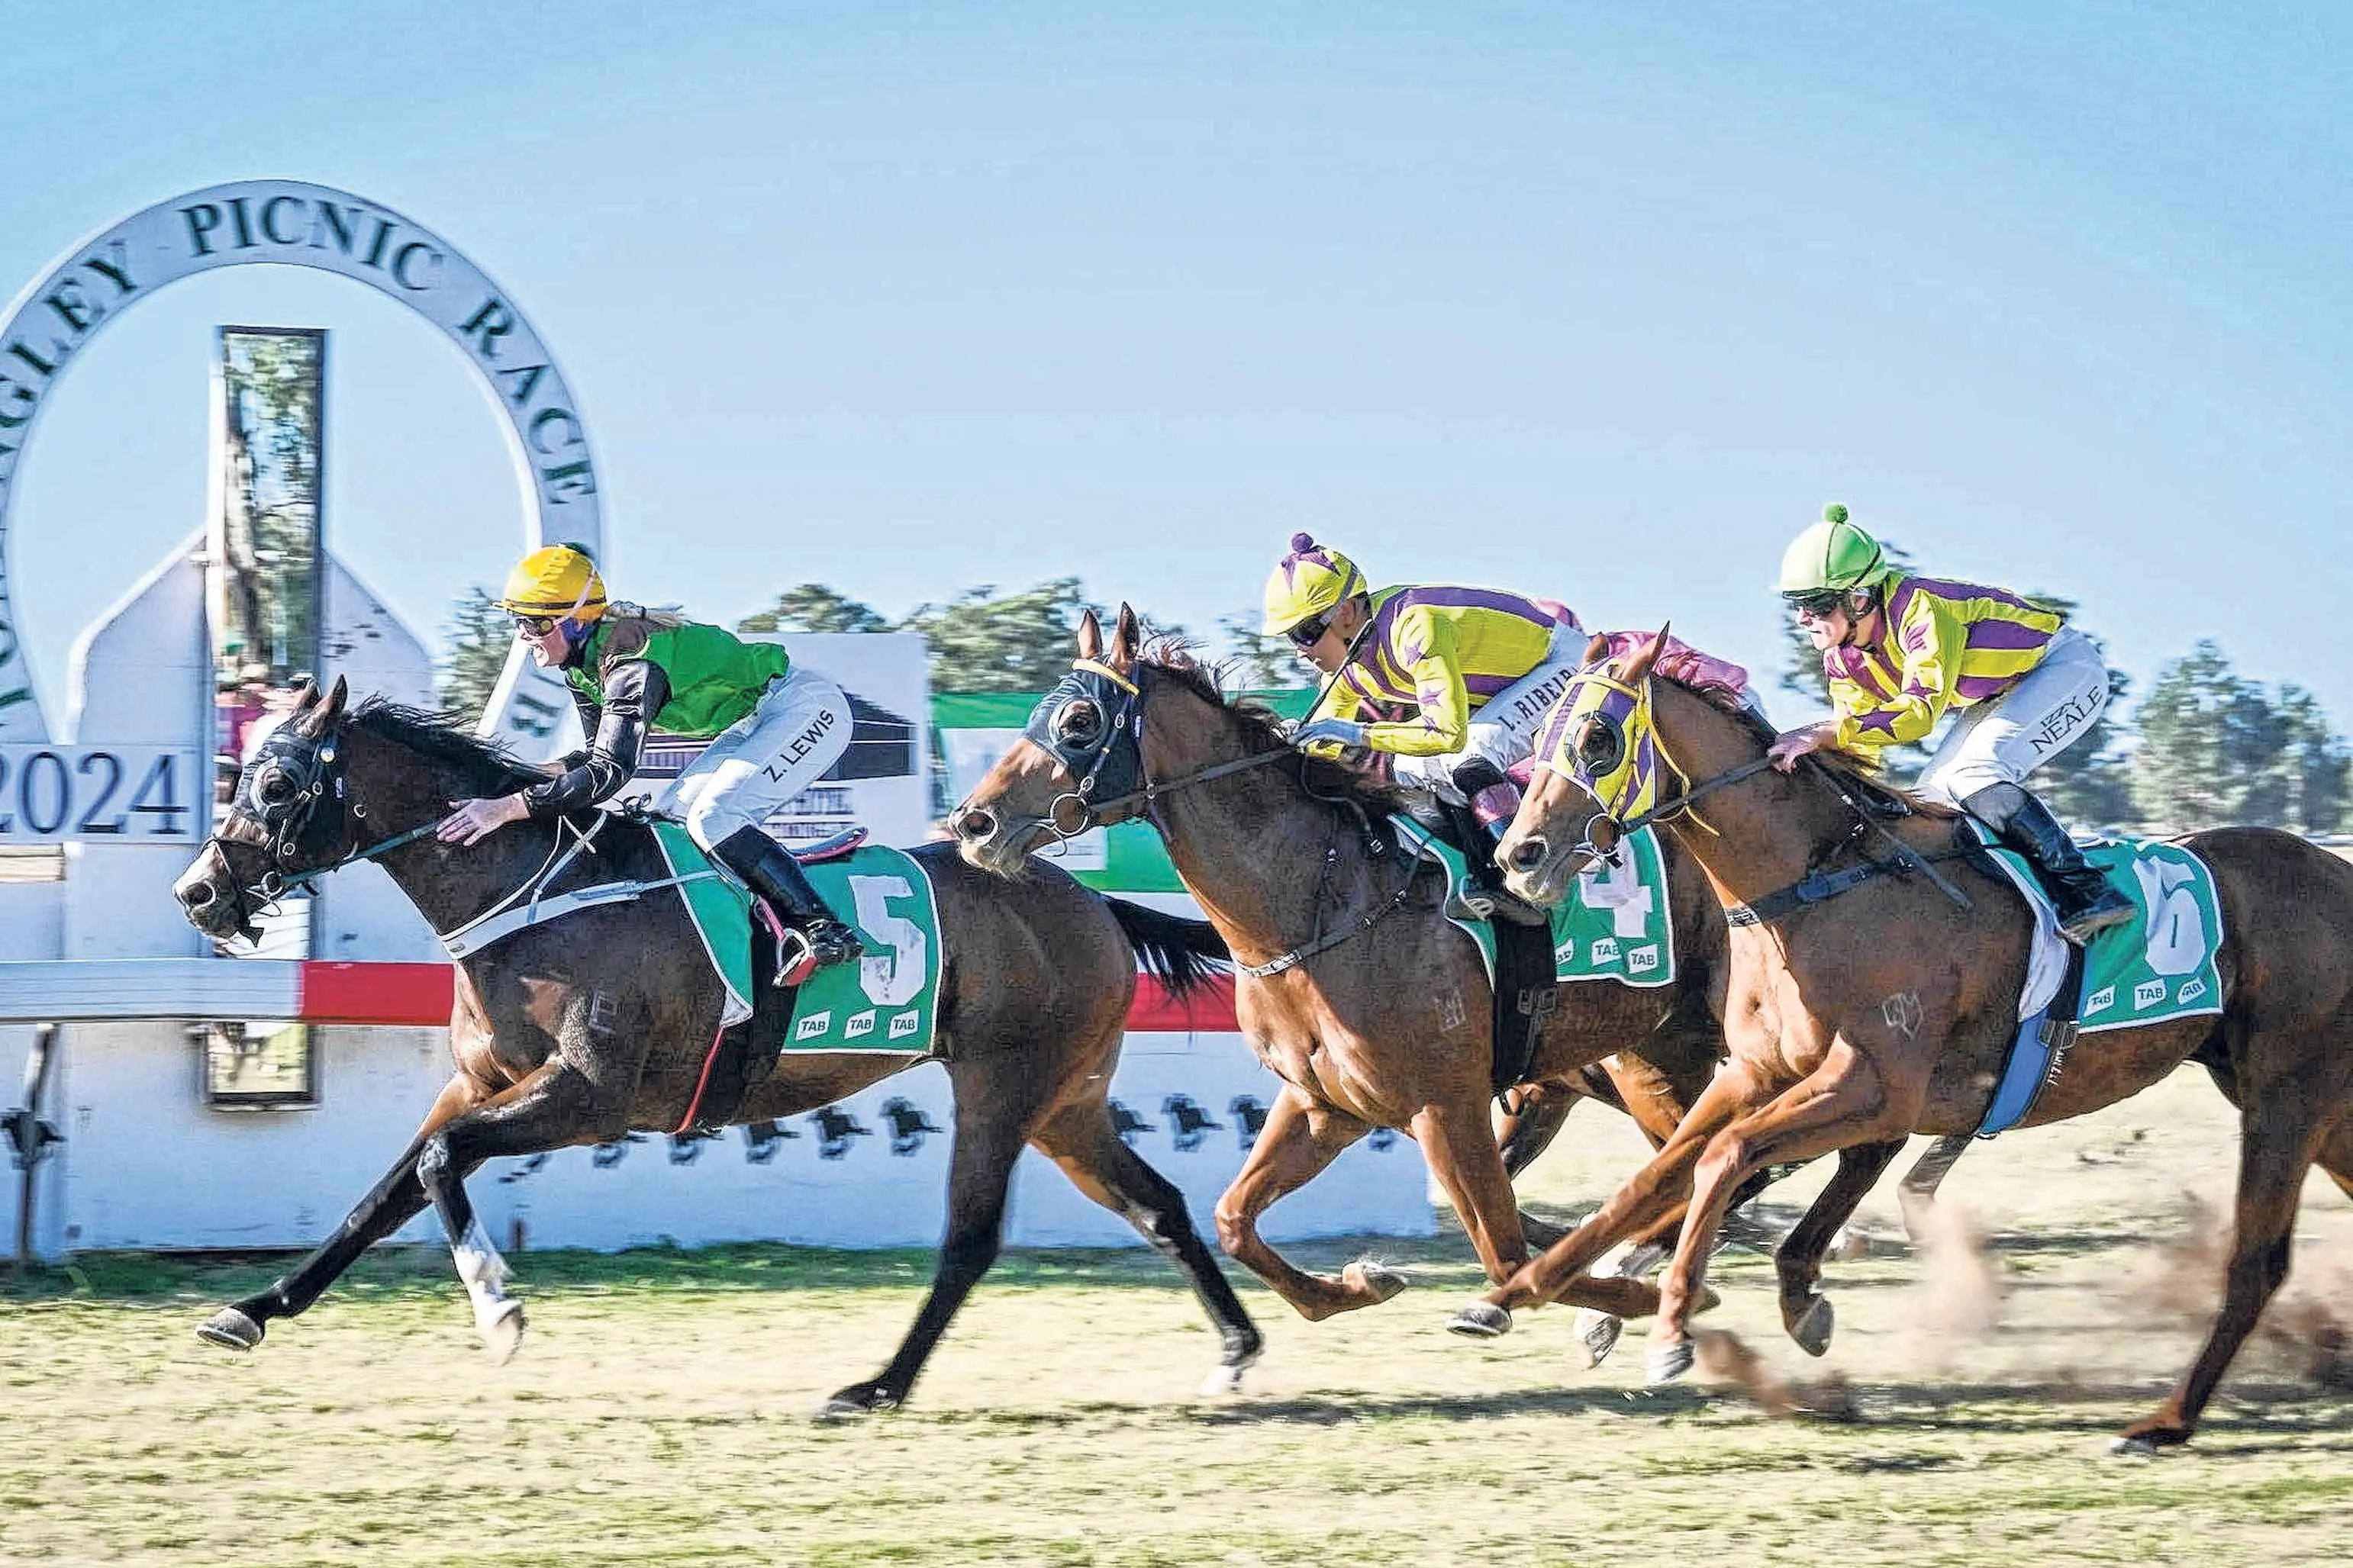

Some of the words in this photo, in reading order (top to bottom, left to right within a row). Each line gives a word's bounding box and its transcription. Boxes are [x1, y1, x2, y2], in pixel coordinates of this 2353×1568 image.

[177, 195, 444, 291] PICNIC
[458, 298, 598, 504] RACE
[762, 765, 788, 783] Z.
[779, 710, 834, 766] LEWIS
[2029, 685, 2103, 754] NEALE
[1578, 836, 1653, 939] 4
[2132, 855, 2206, 976] 6
[847, 874, 927, 1007] 5
[1631, 953, 1655, 966] TAB
[802, 1019, 827, 1032] TAB
[850, 1018, 873, 1031] TAB
[893, 1018, 916, 1030] TAB
[2138, 988, 2164, 1000] TAB
